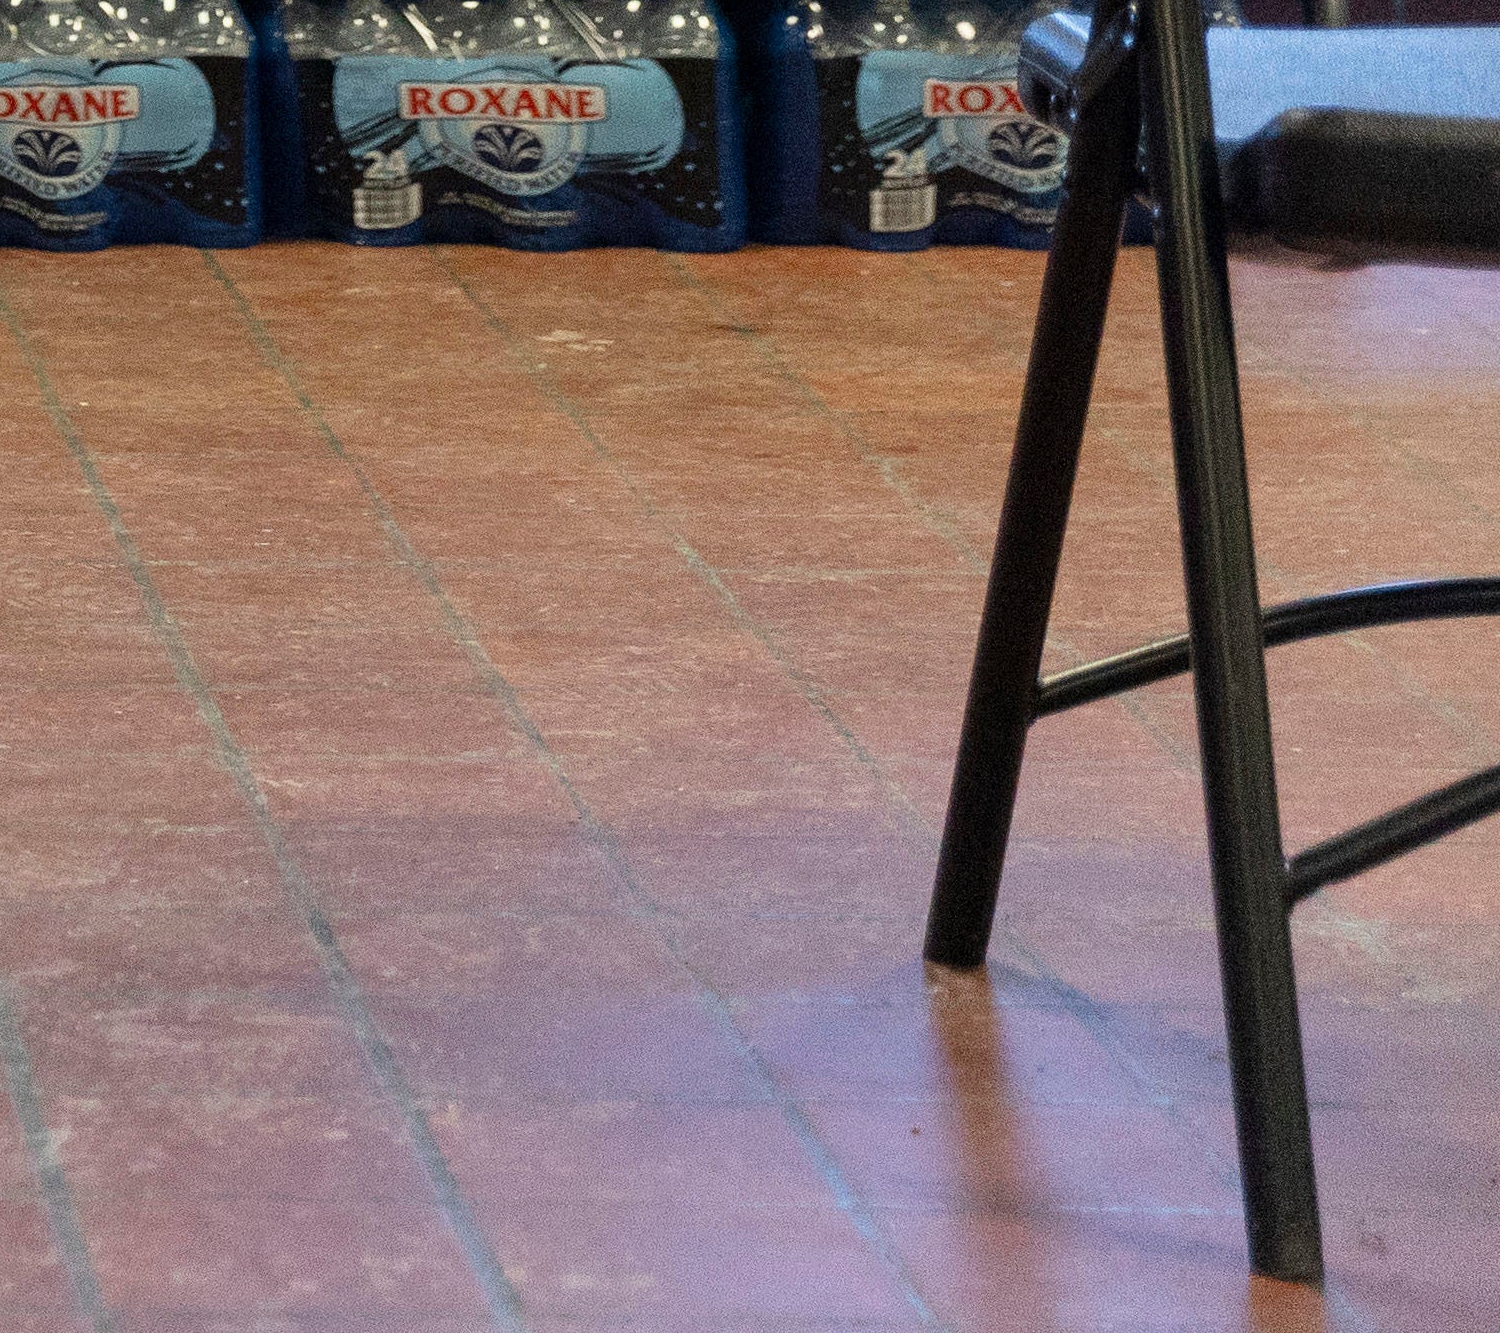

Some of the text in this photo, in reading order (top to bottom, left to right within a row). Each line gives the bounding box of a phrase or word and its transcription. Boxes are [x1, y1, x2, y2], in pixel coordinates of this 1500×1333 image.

[408, 87, 598, 119] ROXANE
[931, 84, 1025, 113] ROX
[364, 151, 407, 179] 24
[883, 149, 926, 177] 24
